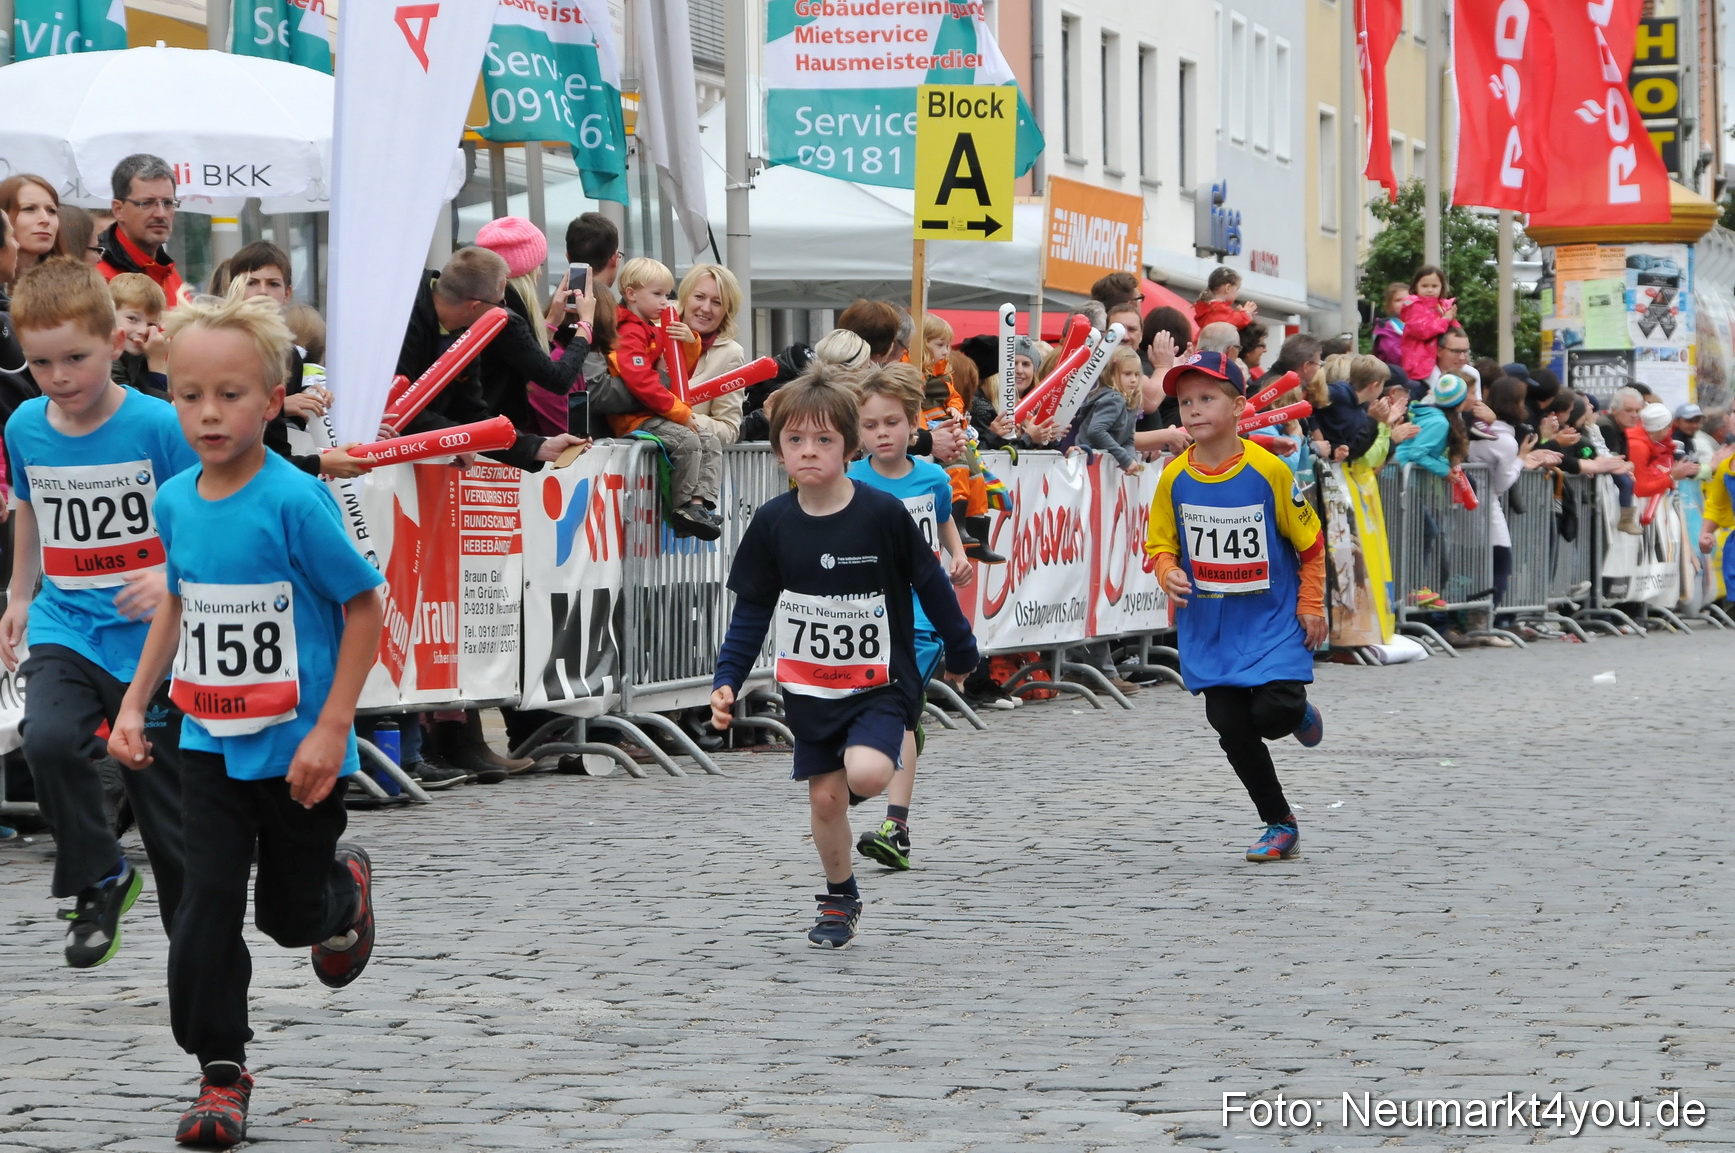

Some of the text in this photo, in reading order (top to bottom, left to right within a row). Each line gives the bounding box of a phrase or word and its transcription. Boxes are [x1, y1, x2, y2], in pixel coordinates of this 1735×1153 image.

[253, 6, 290, 47] Se
[794, 25, 928, 44] Mietservice
[1632, 23, 1678, 157] HOT
[491, 87, 576, 128] 0918
[928, 91, 1004, 119] Block
[203, 164, 272, 187] BKK
[934, 132, 992, 206] A
[366, 441, 429, 460] Audi BKK
[31, 476, 131, 491] PARTL Neumarkt
[464, 489, 519, 504] VERZURRSYST
[43, 491, 149, 542] 7029
[909, 506, 925, 514] arkt
[1184, 512, 1251, 525] PARTL Neumarkt
[919, 517, 933, 547] 0
[1190, 527, 1260, 559] 7143
[74, 553, 126, 572] Lukas
[464, 570, 488, 582] Braun
[1198, 565, 1253, 580] Alexander
[464, 586, 475, 598] Am
[194, 600, 267, 614] Neumarkt
[464, 602, 494, 615] D-92318
[779, 600, 869, 619] PARTL Neumarkt
[464, 625, 477, 637] Tel.
[788, 618, 880, 660] 7538
[464, 641, 477, 654] Fax
[813, 668, 852, 681] Cedric
[194, 691, 246, 714] Kilian
